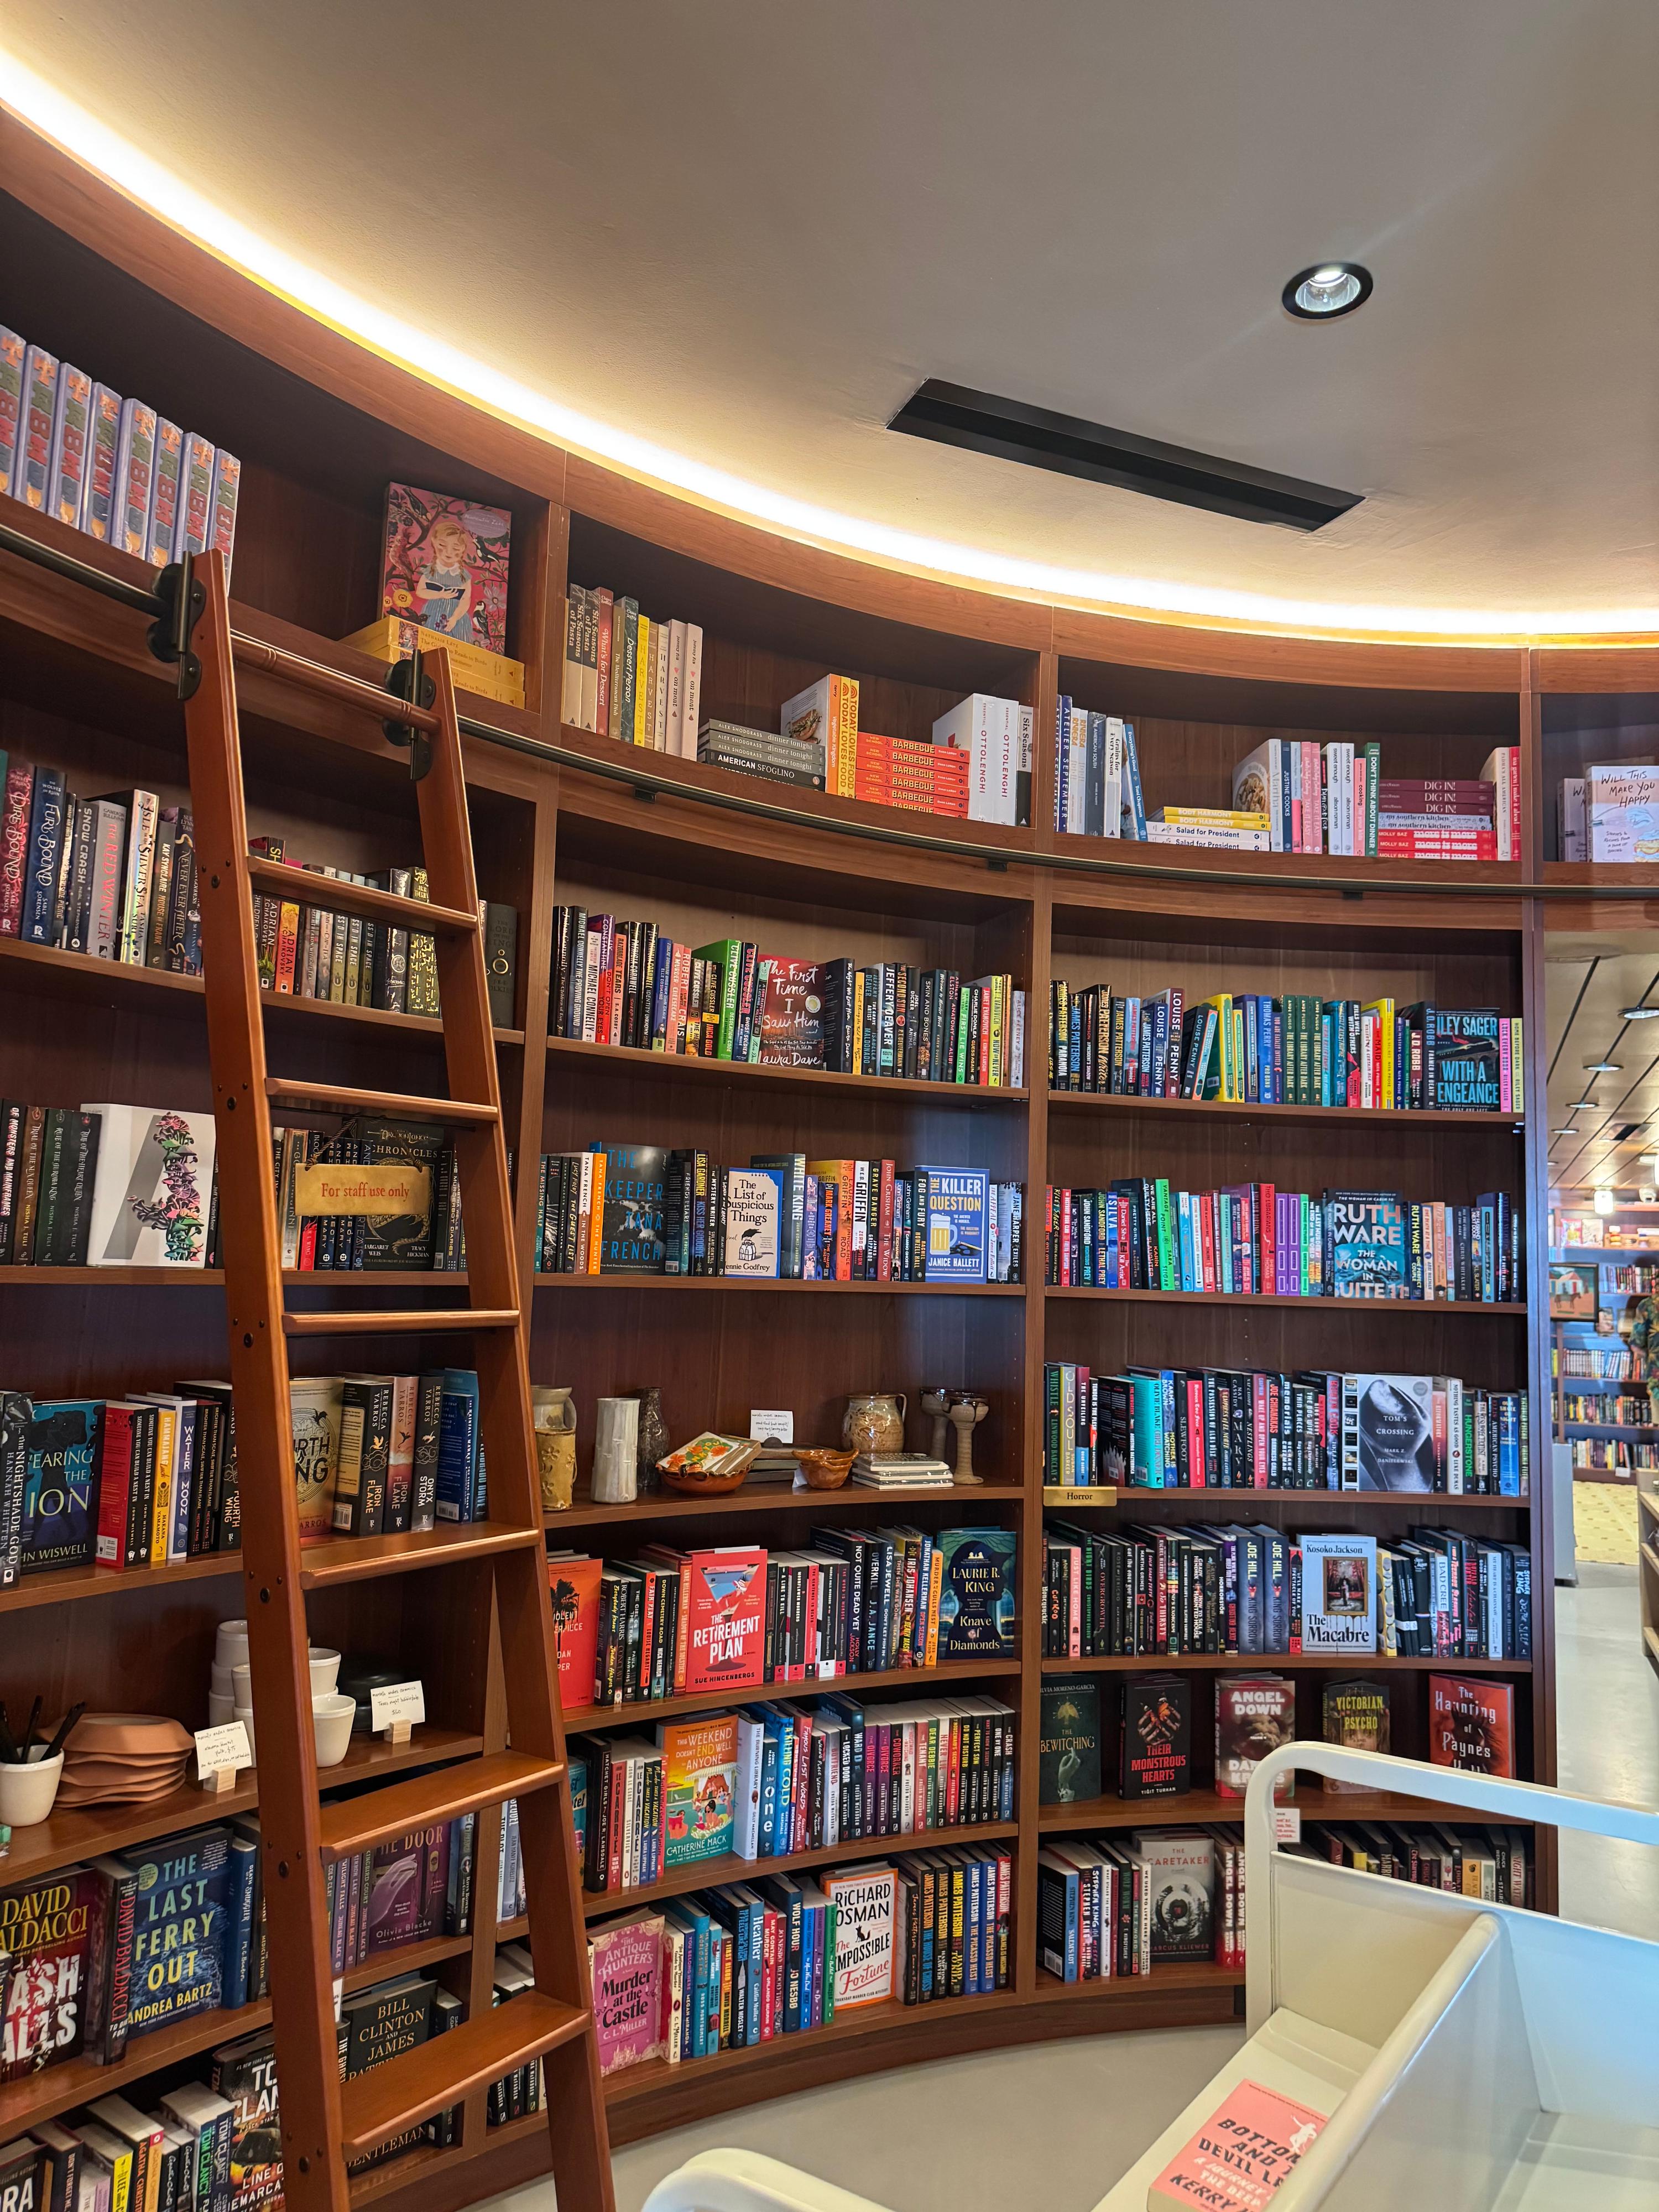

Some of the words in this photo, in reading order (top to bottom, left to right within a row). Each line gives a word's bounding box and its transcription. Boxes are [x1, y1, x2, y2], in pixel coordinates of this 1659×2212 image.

[625, 677, 633, 702] Person
[893, 740, 935, 754] BARBECUE
[718, 754, 755, 769] AMERICAN
[758, 763, 794, 779] SFOGLINO
[1601, 774, 1626, 784] WILL
[1627, 770, 1647, 779] THIS
[1619, 795, 1650, 808] HAPPY
[82, 808, 92, 842] SNOW
[1208, 828, 1239, 838] President
[77, 844, 90, 883] CRASH
[765, 959, 786, 975] The
[789, 964, 818, 984] First
[773, 978, 807, 995] Time
[885, 967, 894, 1011] JEFFERY
[784, 999, 794, 1014] I
[1172, 992, 1182, 1030] LOUISE
[762, 1015, 791, 1029] Saw
[794, 1011, 819, 1027] Him
[884, 1009, 894, 1045] DEAVER
[1437, 1016, 1462, 1035] ILEY
[1463, 1017, 1498, 1036] SAGER
[792, 1052, 820, 1065] Dave
[1169, 1046, 1178, 1081] PENNY
[1442, 1061, 1474, 1081] WITH
[1478, 1062, 1486, 1082] A
[1437, 1083, 1499, 1103] ENGEANCE
[607, 1150, 636, 1168] THE
[739, 1180, 756, 1188] The
[794, 1157, 804, 1196] WHITE
[930, 1177, 940, 1193] THE
[321, 1183, 341, 1197] For
[344, 1182, 368, 1197] staff
[370, 1187, 385, 1196] use
[389, 1183, 409, 1202] only
[606, 1180, 664, 1201] KEEPER
[734, 1188, 754, 1199] List
[942, 1178, 981, 1195] KILLER
[727, 1197, 774, 1211] Suspicious
[792, 1197, 804, 1221] KING
[930, 1197, 981, 1212] QUESTION
[625, 1212, 662, 1230] TANA
[731, 1211, 767, 1226] Things
[1334, 1204, 1400, 1224] RUTH
[1334, 1225, 1401, 1245] WARE
[602, 1241, 660, 1261] FRENCH
[743, 1263, 770, 1272] Godfrey
[928, 1258, 951, 1266] JANICE
[953, 1258, 980, 1267] HALLETT
[1336, 1259, 1397, 1271] WOMAN
[184, 1426, 195, 1469] WATER
[28, 1449, 92, 1468] EARING
[64, 1469, 86, 1481] THE
[11, 1451, 25, 1532] NIGHTSHADE
[180, 1481, 190, 1516] MOON
[418, 1476, 427, 1506] STORM
[9, 1536, 19, 1564] GOD
[44, 1543, 87, 1558] WISWELL
[1247, 1542, 1256, 1558] JOE
[1306, 1544, 1332, 1554] Kosoko
[1334, 1545, 1363, 1554] Jackson
[952, 1567, 989, 1579] LAURIE
[992, 1567, 1000, 1578] R.
[1247, 1559, 1256, 1578] HILL
[964, 1582, 995, 1592] KING
[711, 1614, 723, 1624] THE
[960, 1616, 992, 1626] Knave
[1307, 1614, 1327, 1626] The
[693, 1616, 760, 1647] RETIREMENT
[1307, 1626, 1369, 1644] Macabre
[710, 1638, 743, 1664] PLAN
[950, 1640, 1000, 1650] Diamonds
[709, 1672, 754, 1682] HINCENBERGS
[1053, 1684, 1095, 1692] MORENO-GARCIA
[1230, 1691, 1285, 1703] ANGEL
[1458, 1687, 1473, 1699] The
[1235, 1703, 1281, 1714] DOWN
[1336, 1696, 1384, 1710] VICTORIAN
[1435, 1691, 1496, 1724] Haunting
[1343, 1717, 1378, 1729] PSYCHO
[1464, 1724, 1472, 1733] of
[688, 1728, 732, 1744] WEEKEND
[1040, 1736, 1095, 1753] BEWITCHING
[1443, 1731, 1491, 1758] Paynes
[697, 1744, 713, 1756] END
[716, 1741, 732, 1752] WELL
[1147, 1744, 1171, 1756] THEIR
[686, 1754, 722, 1770] ANYONE
[1131, 1755, 1186, 1771] MONSTROUS
[1142, 1770, 1175, 1783] HEARTS
[405, 1826, 443, 1850] DOOR
[667, 1839, 706, 1855] CATHERINE
[708, 1834, 727, 1845] MACK
[163, 1854, 197, 1882] THE
[1146, 1856, 1210, 1865] CARETAKER
[3, 1885, 70, 1924] DAVID
[149, 1879, 208, 1922] LAST
[836, 1901, 890, 1927] OSMAN
[0, 1905, 89, 1953] ALDACCI
[135, 1910, 215, 1960] FERRY
[752, 1916, 763, 1960] Heather
[605, 1942, 651, 1962] ANTIQUE
[836, 1940, 850, 1952] The
[148, 1950, 199, 1991] OUT
[598, 1952, 653, 1980] HUNTER'S
[601, 1970, 653, 2000] Murder
[839, 1959, 889, 1995] Fortune
[127, 1994, 173, 2026] ANDREA
[176, 1982, 213, 2006] BARTZ
[613, 1996, 624, 2007] at
[626, 1989, 641, 2002] the
[378, 1998, 410, 2020] BILL
[603, 2000, 648, 2028] Castle
[359, 2008, 425, 2042] CLINTON
[619, 2018, 647, 2035] MILLER
[385, 2031, 398, 2039] AND
[367, 2032, 415, 2061] JAMES
[1198, 2137, 1253, 2175] DEVIL
[1232, 2141, 1278, 2167] AND
[242, 2171, 272, 2190] LINE
[1170, 2173, 1238, 2208] KERRY
